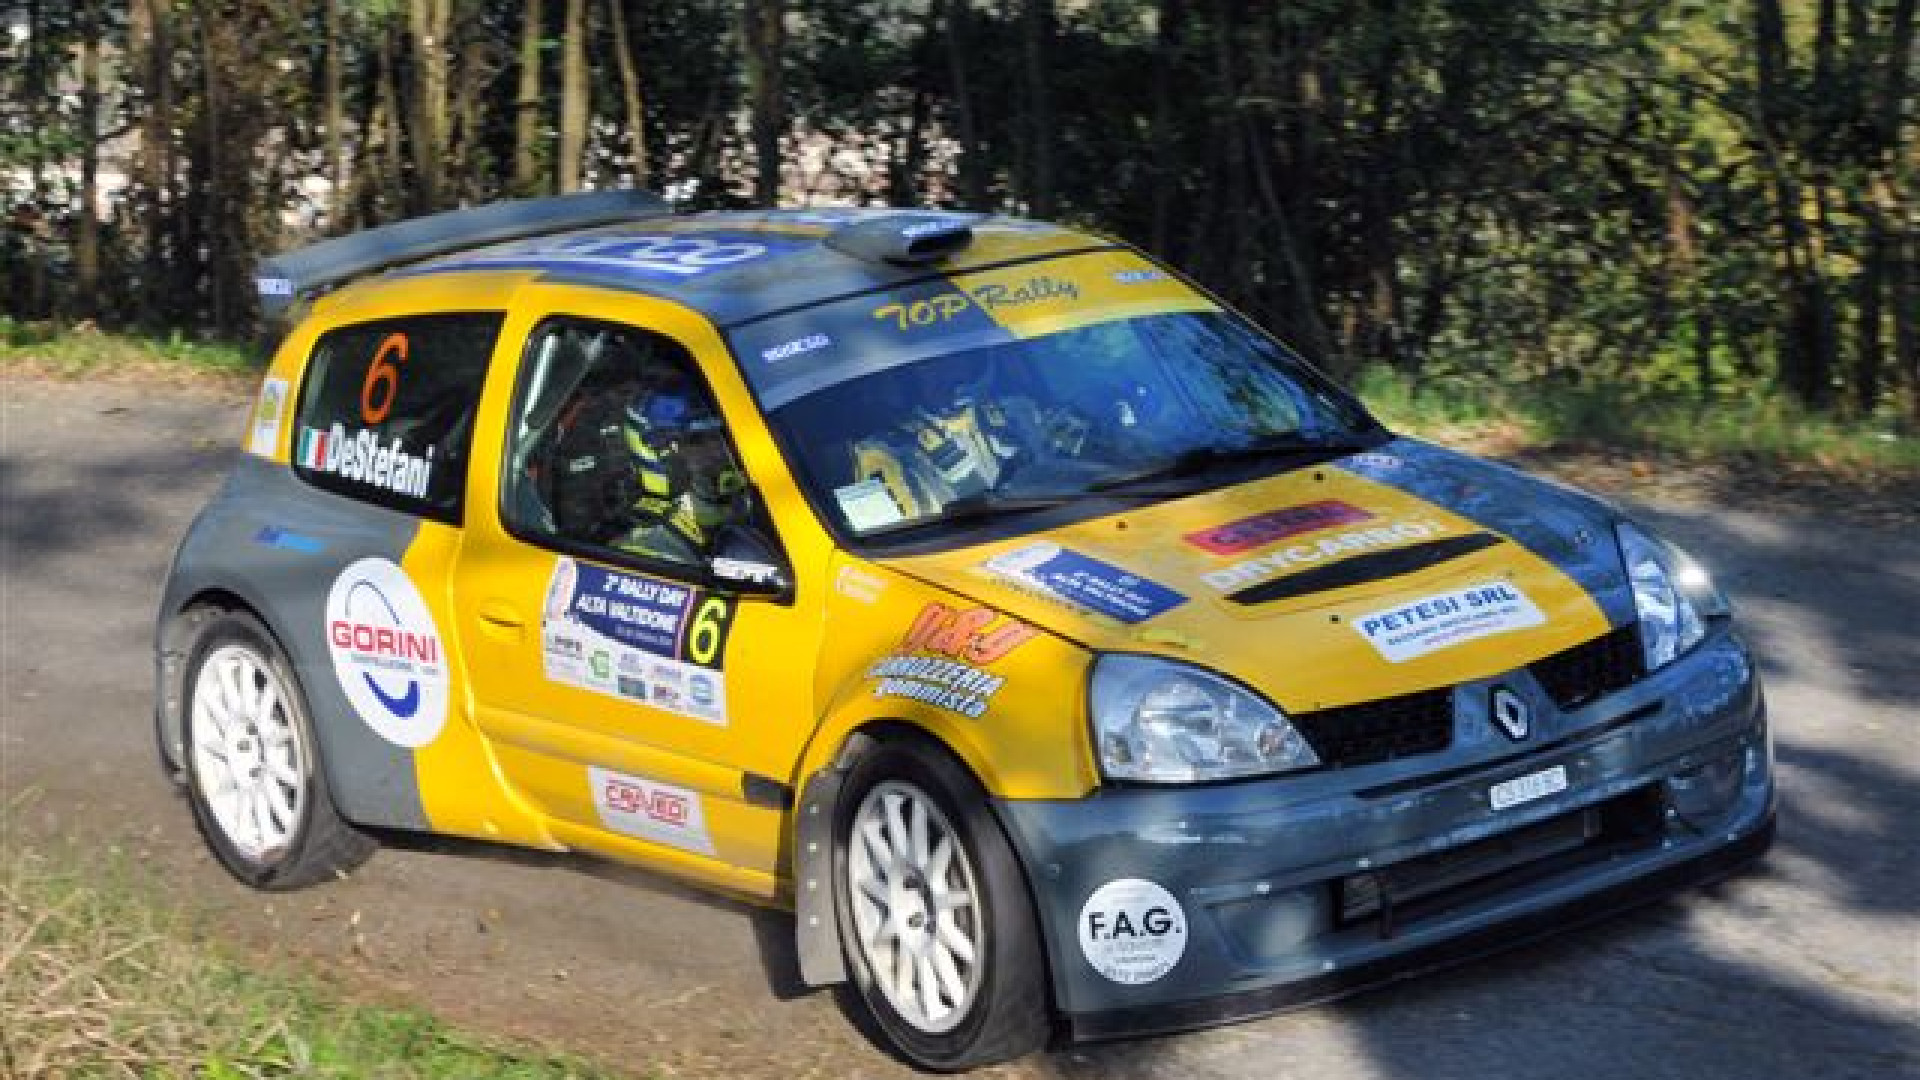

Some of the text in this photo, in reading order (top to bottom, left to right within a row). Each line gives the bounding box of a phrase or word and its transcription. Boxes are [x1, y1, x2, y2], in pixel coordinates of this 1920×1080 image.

[974, 276, 1079, 313] Rally
[360, 332, 410, 426] 6
[326, 422, 434, 499] DeStefani
[575, 592, 607, 614] ALTA
[618, 576, 658, 599] RALLY
[658, 584, 689, 606] DAY
[1363, 596, 1460, 638] PETESI
[1464, 584, 1517, 609] SRL
[331, 621, 440, 664] GORINI
[689, 597, 727, 665] 6
[1087, 905, 1184, 942] F.A.G.
